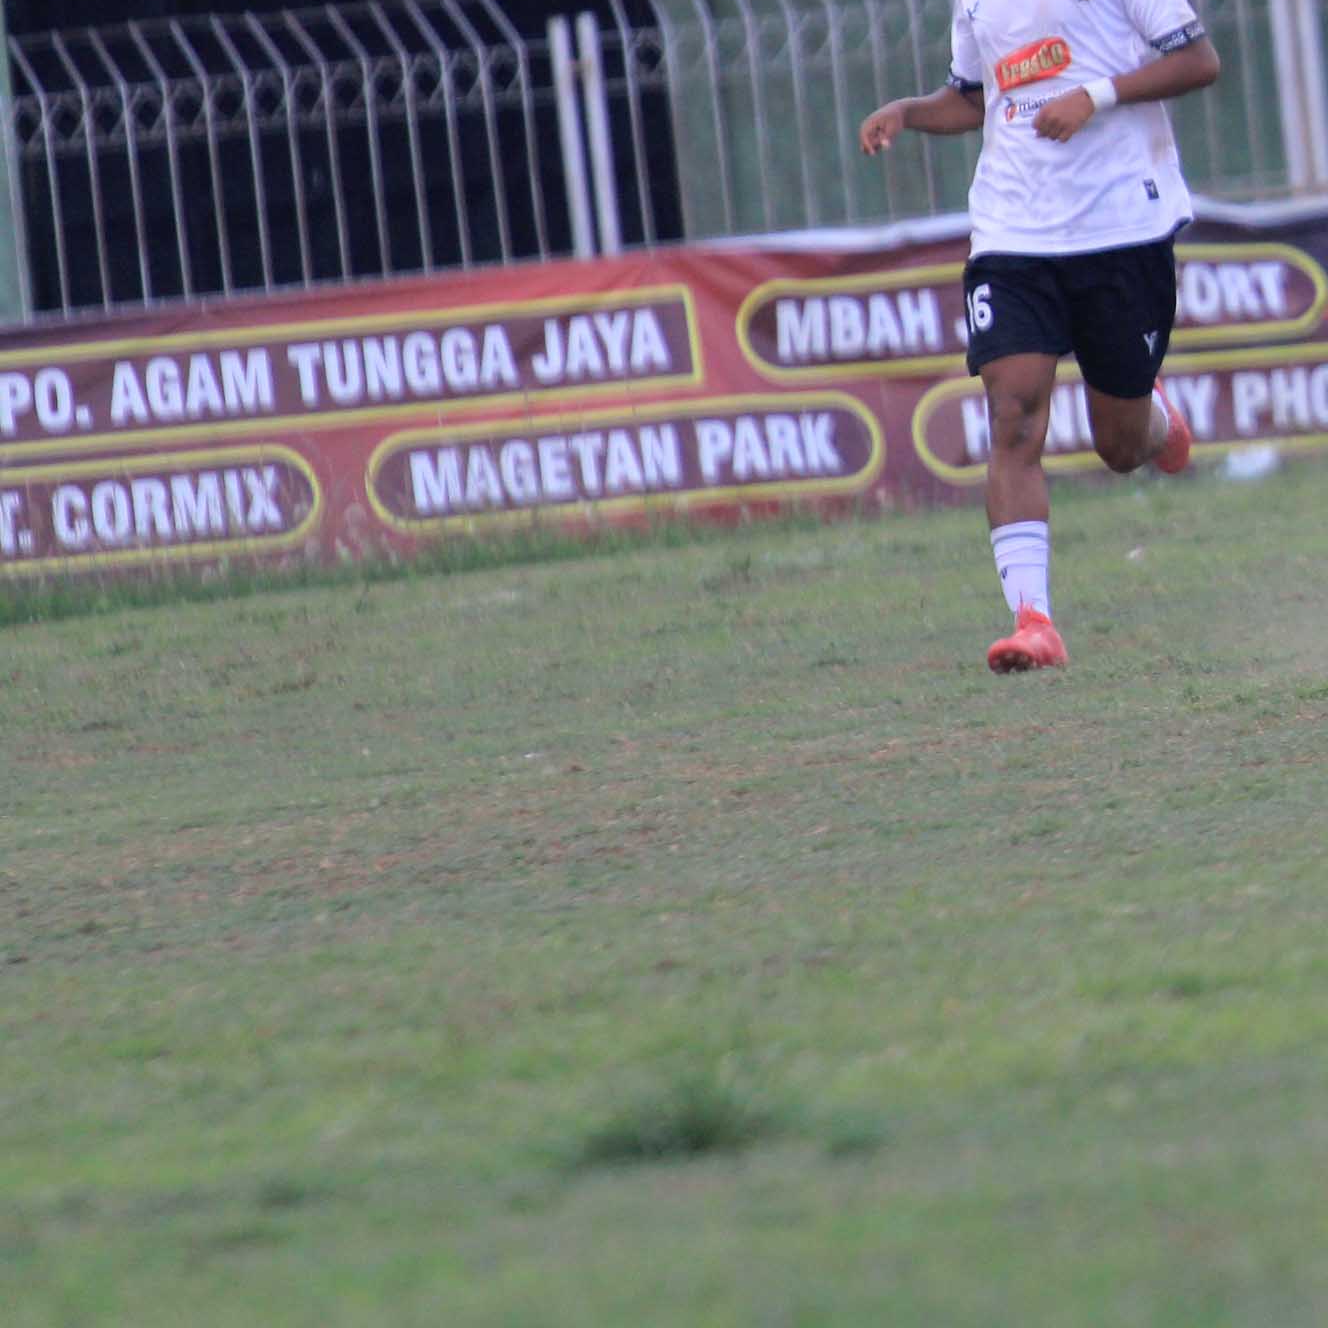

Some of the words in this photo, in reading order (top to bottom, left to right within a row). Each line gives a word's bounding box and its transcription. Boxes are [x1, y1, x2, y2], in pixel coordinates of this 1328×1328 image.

[774, 286, 944, 364] MBAH
[1176, 258, 1288, 324] ORT
[109, 345, 276, 426] AGAM
[287, 323, 518, 410] TUNGGA
[531, 306, 672, 378] JAYA
[52, 466, 286, 552] CORMIX
[408, 422, 683, 516] MAGETAN
[696, 410, 846, 483] PARK
